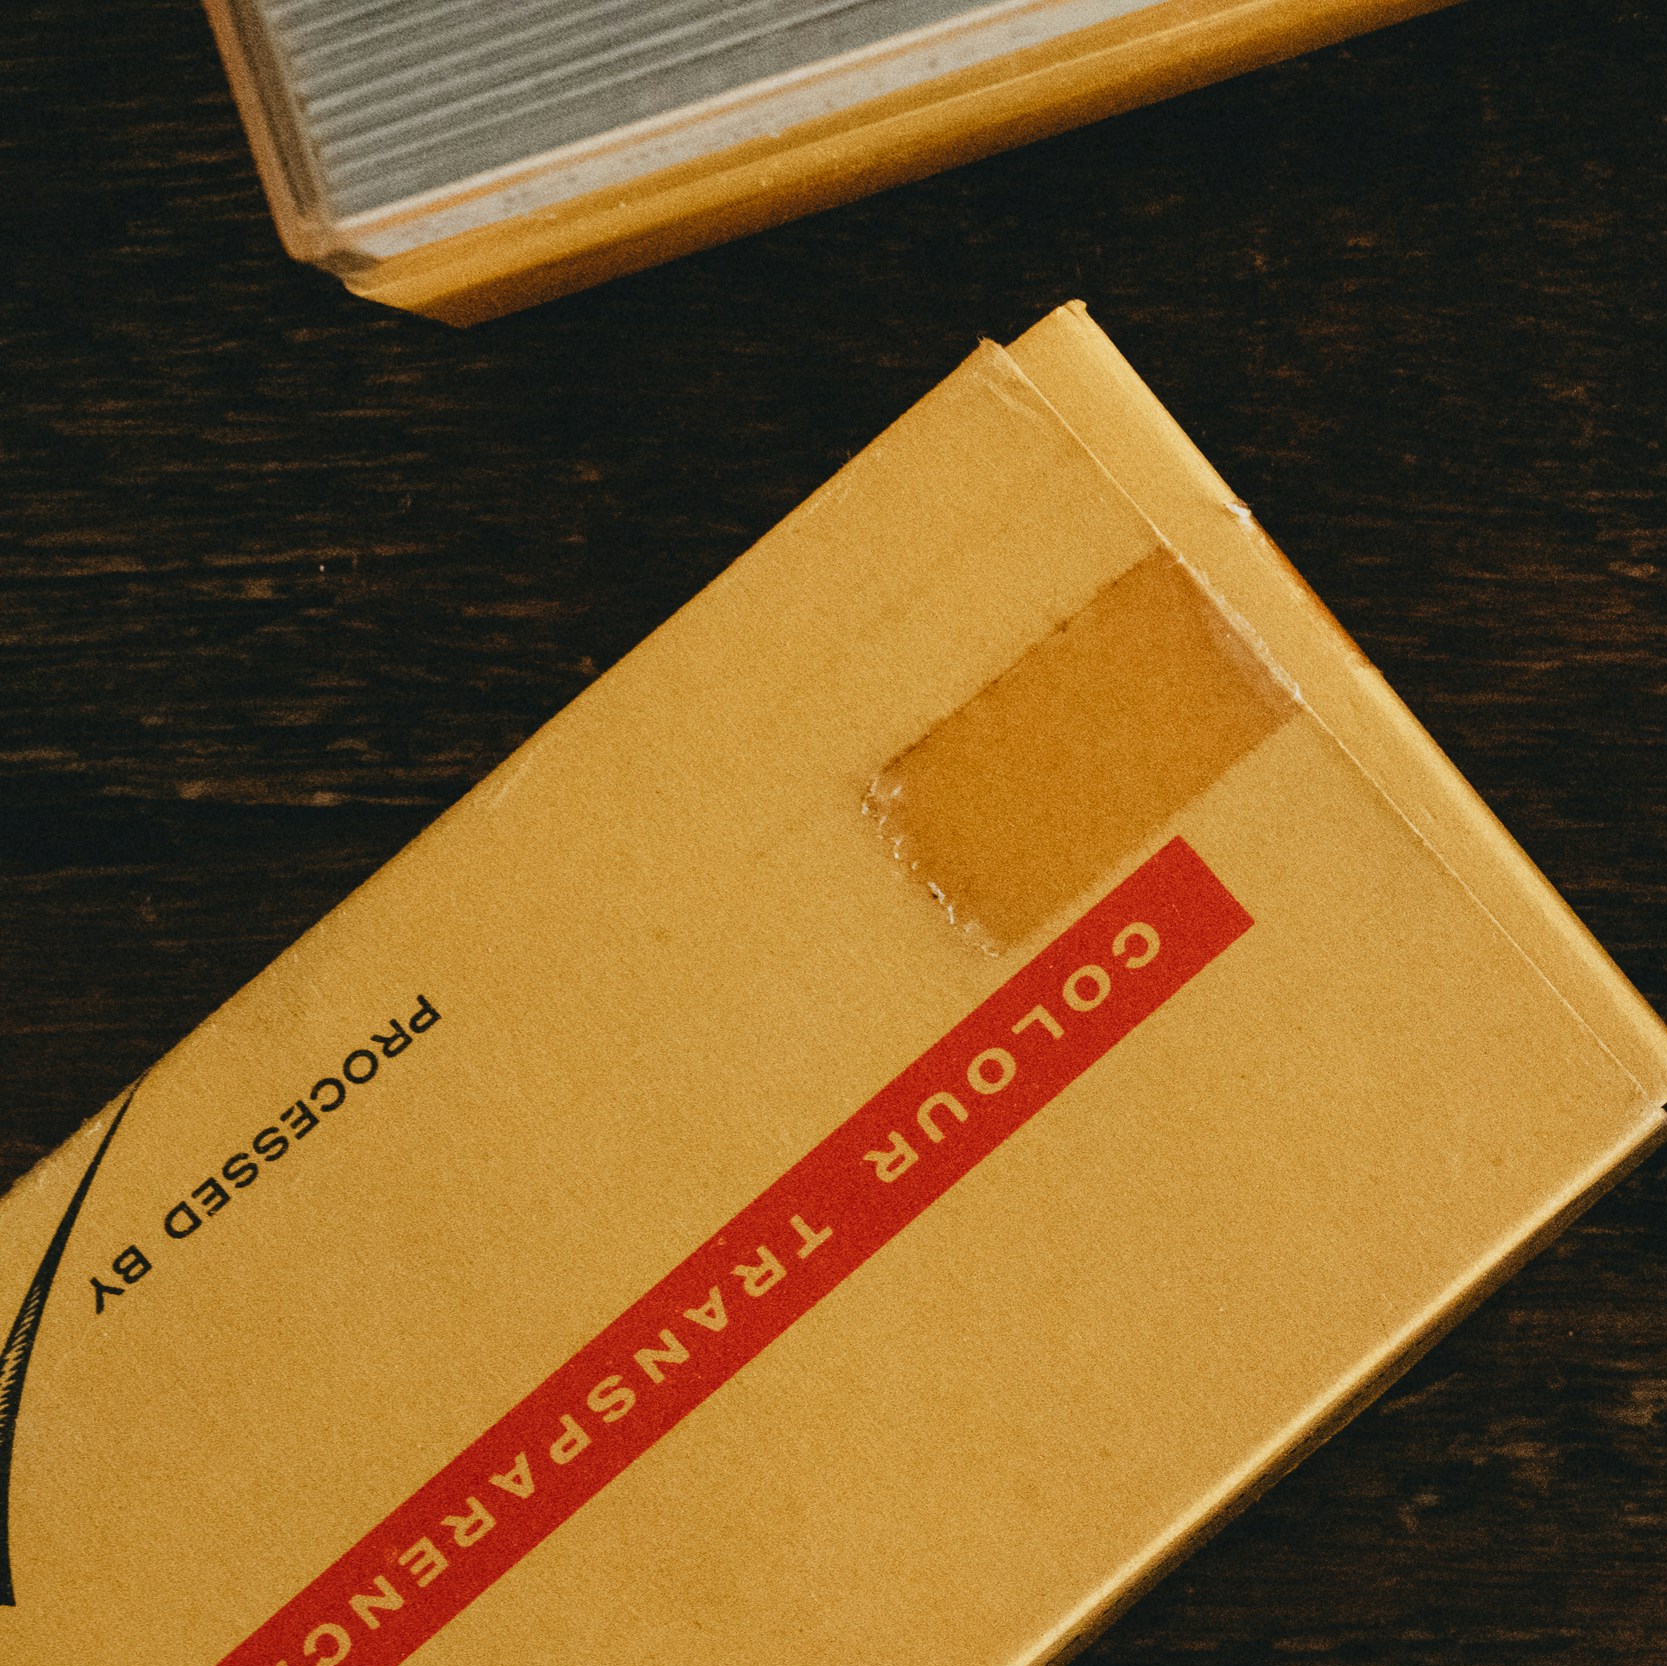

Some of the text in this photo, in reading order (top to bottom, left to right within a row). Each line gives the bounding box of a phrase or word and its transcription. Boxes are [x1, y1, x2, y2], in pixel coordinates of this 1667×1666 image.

[89, 994, 441, 1315] PROCESSED BY
[861, 920, 1161, 1184] COLOUR
